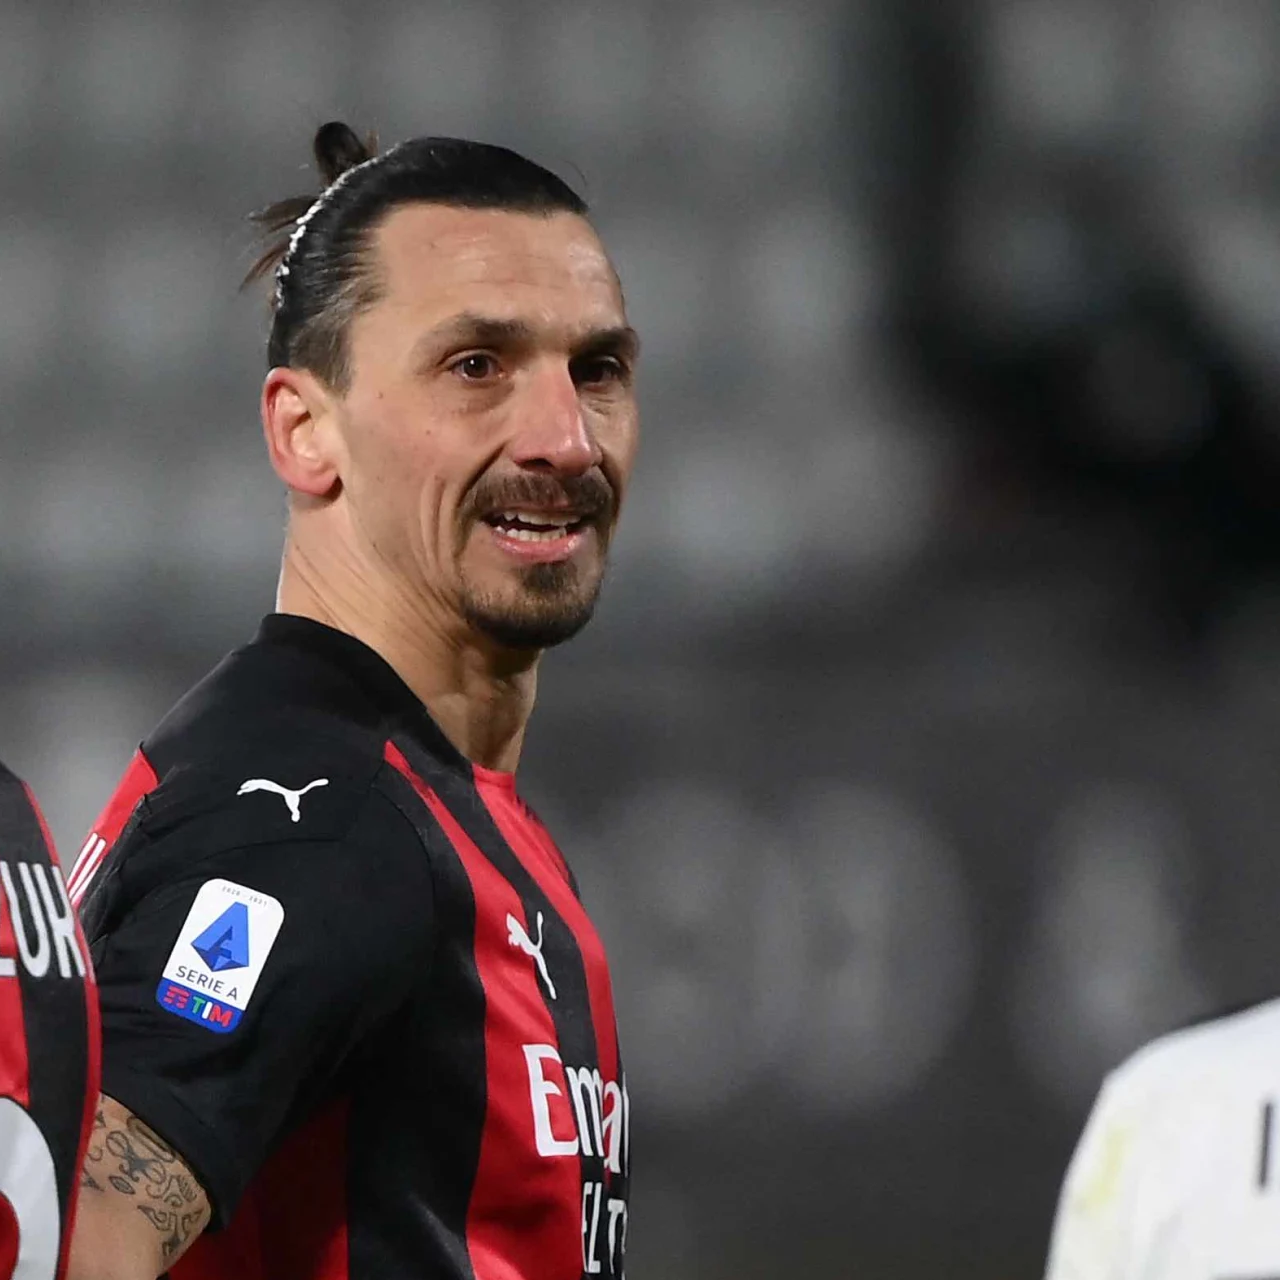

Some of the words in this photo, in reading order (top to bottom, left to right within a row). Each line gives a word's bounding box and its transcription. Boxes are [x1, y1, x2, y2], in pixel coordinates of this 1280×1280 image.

[176, 965, 225, 995] SERIE
[227, 986, 239, 1001] A
[192, 995, 234, 1028] TIM
